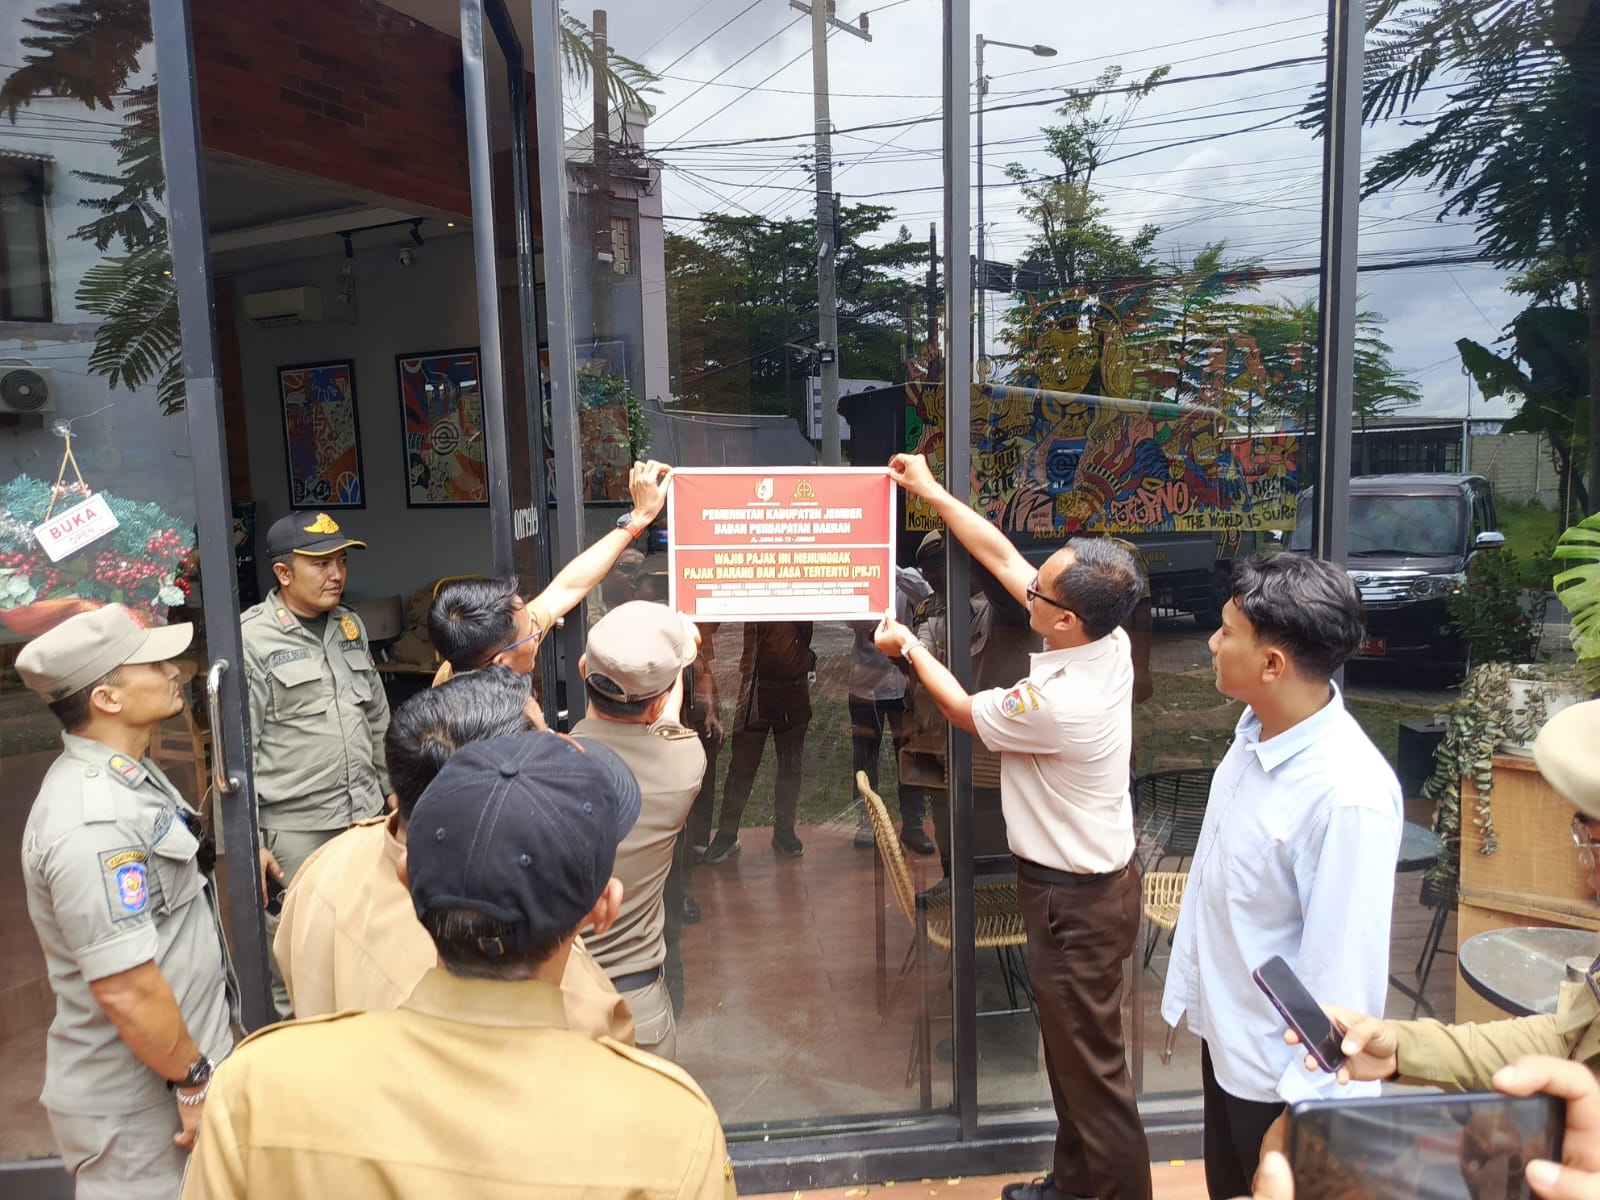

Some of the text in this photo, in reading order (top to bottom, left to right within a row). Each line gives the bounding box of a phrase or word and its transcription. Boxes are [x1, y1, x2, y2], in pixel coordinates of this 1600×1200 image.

[765, 508, 822, 520] KABUPATEN
[823, 507, 863, 520] JEMBER
[1209, 512, 1243, 528] WORLD
[1247, 512, 1261, 528] IS
[49, 508, 97, 540] BUKA
[714, 521, 851, 535] BADAN PENDAPATAN DAERAH
[714, 552, 851, 565] WAJIB PAJAK INI MENUNGGAK
[683, 566, 881, 580] PAJAK BARANG DAN JASA TERTENTU (PBJT)
